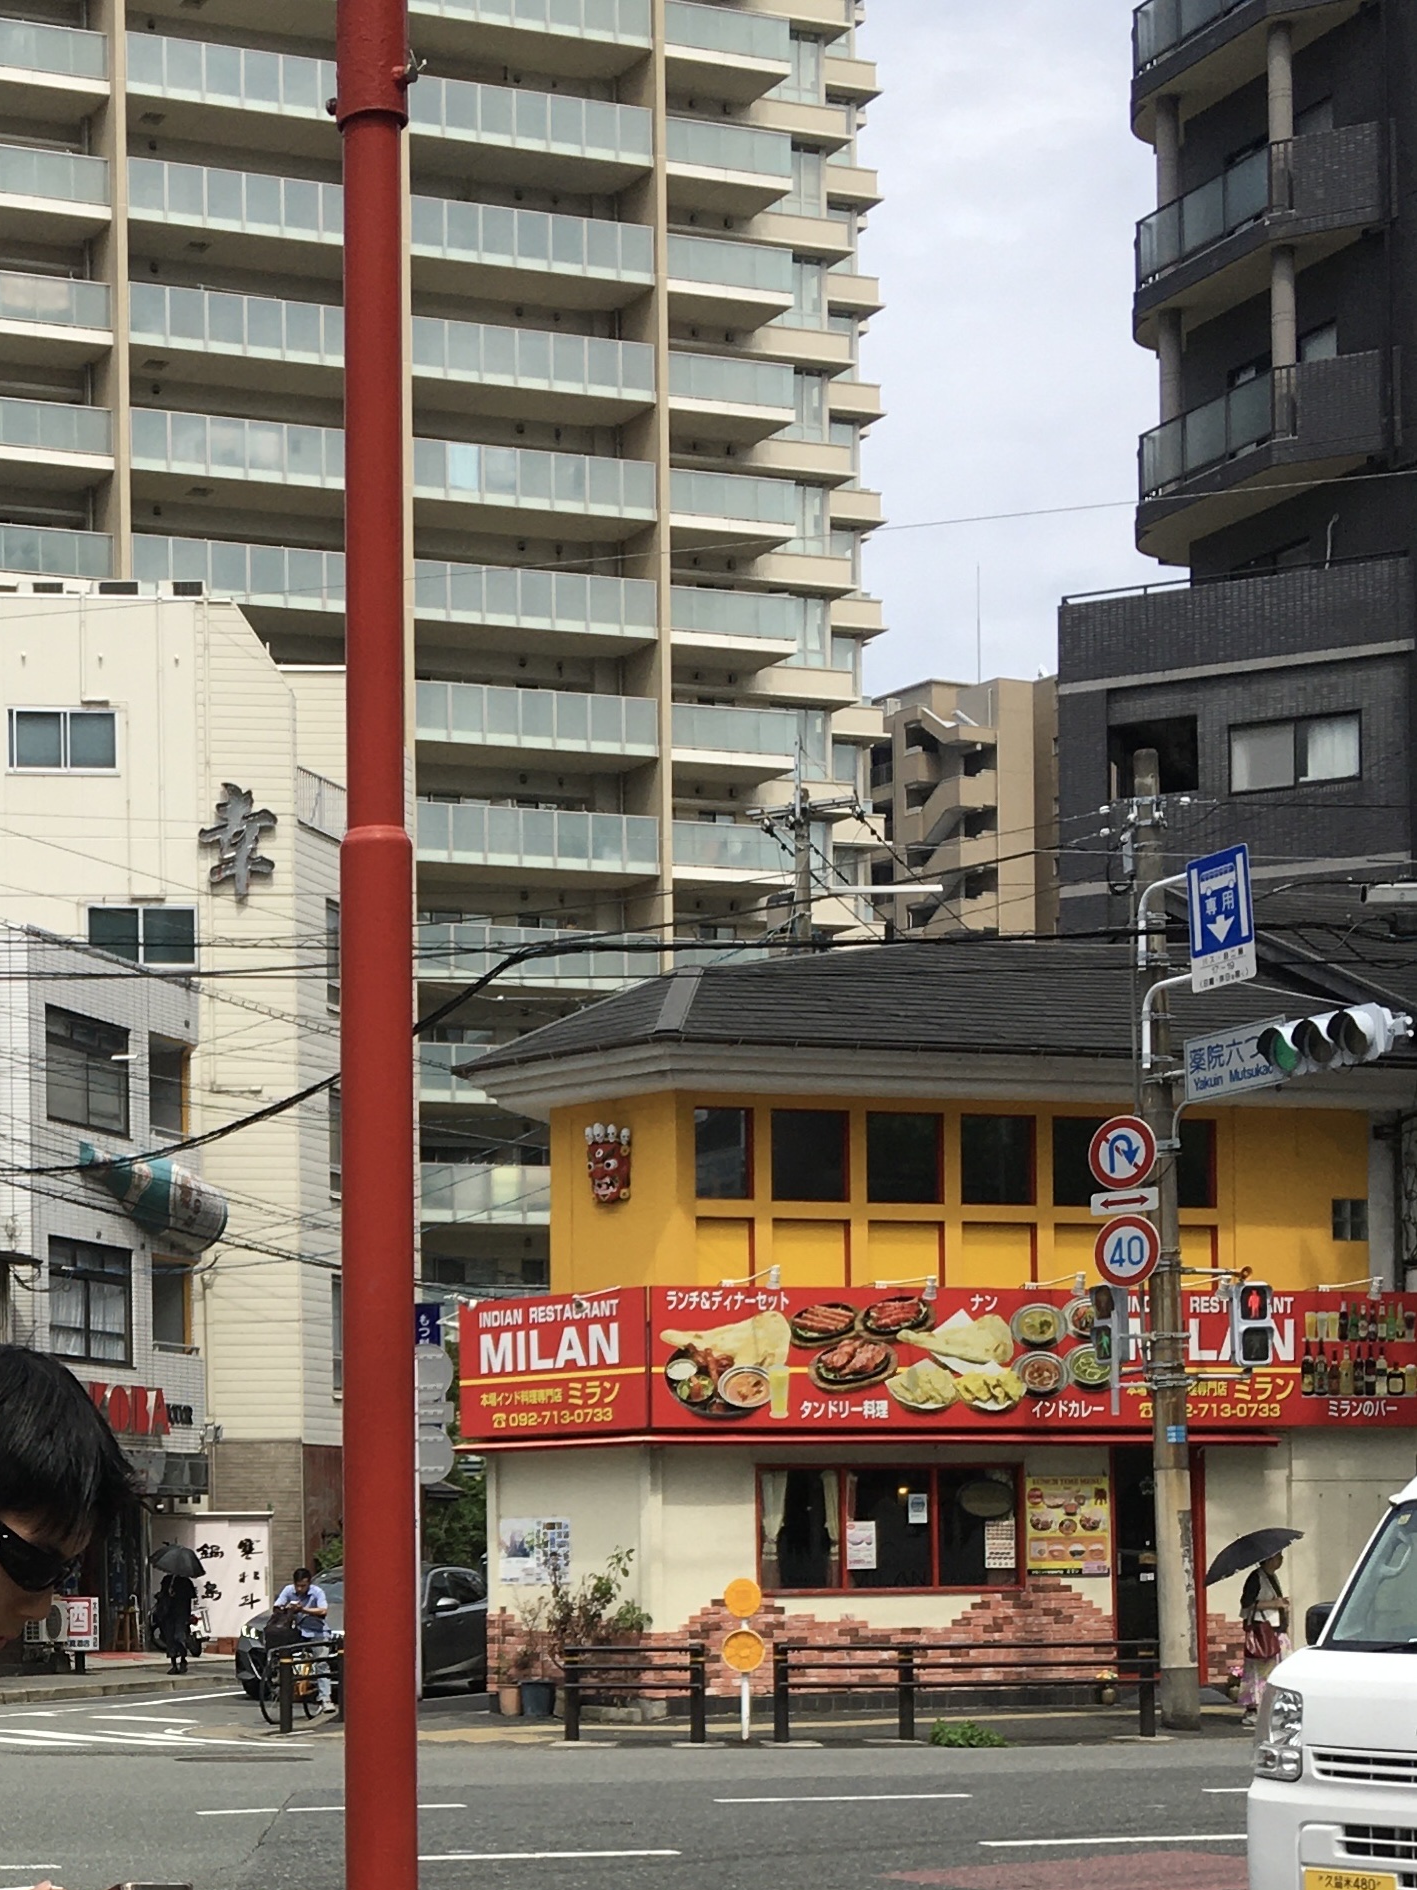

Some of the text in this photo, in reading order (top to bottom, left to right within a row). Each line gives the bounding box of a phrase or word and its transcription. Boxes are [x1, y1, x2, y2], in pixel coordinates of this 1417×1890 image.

[1205, 889, 1235, 916] 専用
[1189, 1035, 1261, 1075] 薬院六つ
[1194, 1074, 1224, 1092] Yakuin
[1109, 1235, 1144, 1267] 40
[666, 1291, 789, 1311] ランチ&ディナーセット
[970, 1294, 998, 1311] ナン
[1189, 1296, 1294, 1314] RESTNT
[478, 1299, 620, 1329] INDIAN RESTAURANT
[480, 1322, 620, 1375] MILAN
[480, 1382, 620, 1407] 本場インド料理専門店 ミラン
[1234, 1377, 1294, 1400] ミラン
[508, 1407, 613, 1427] 092-713-0733
[800, 1400, 889, 1419] タンドリー料理
[1032, 1400, 1105, 1418] インドカレー
[1185, 1403, 1280, 1418] 2-713-0733
[1328, 1400, 1398, 1417] ミランのバー
[1325, 1875, 1376, 1890] 久留米480
